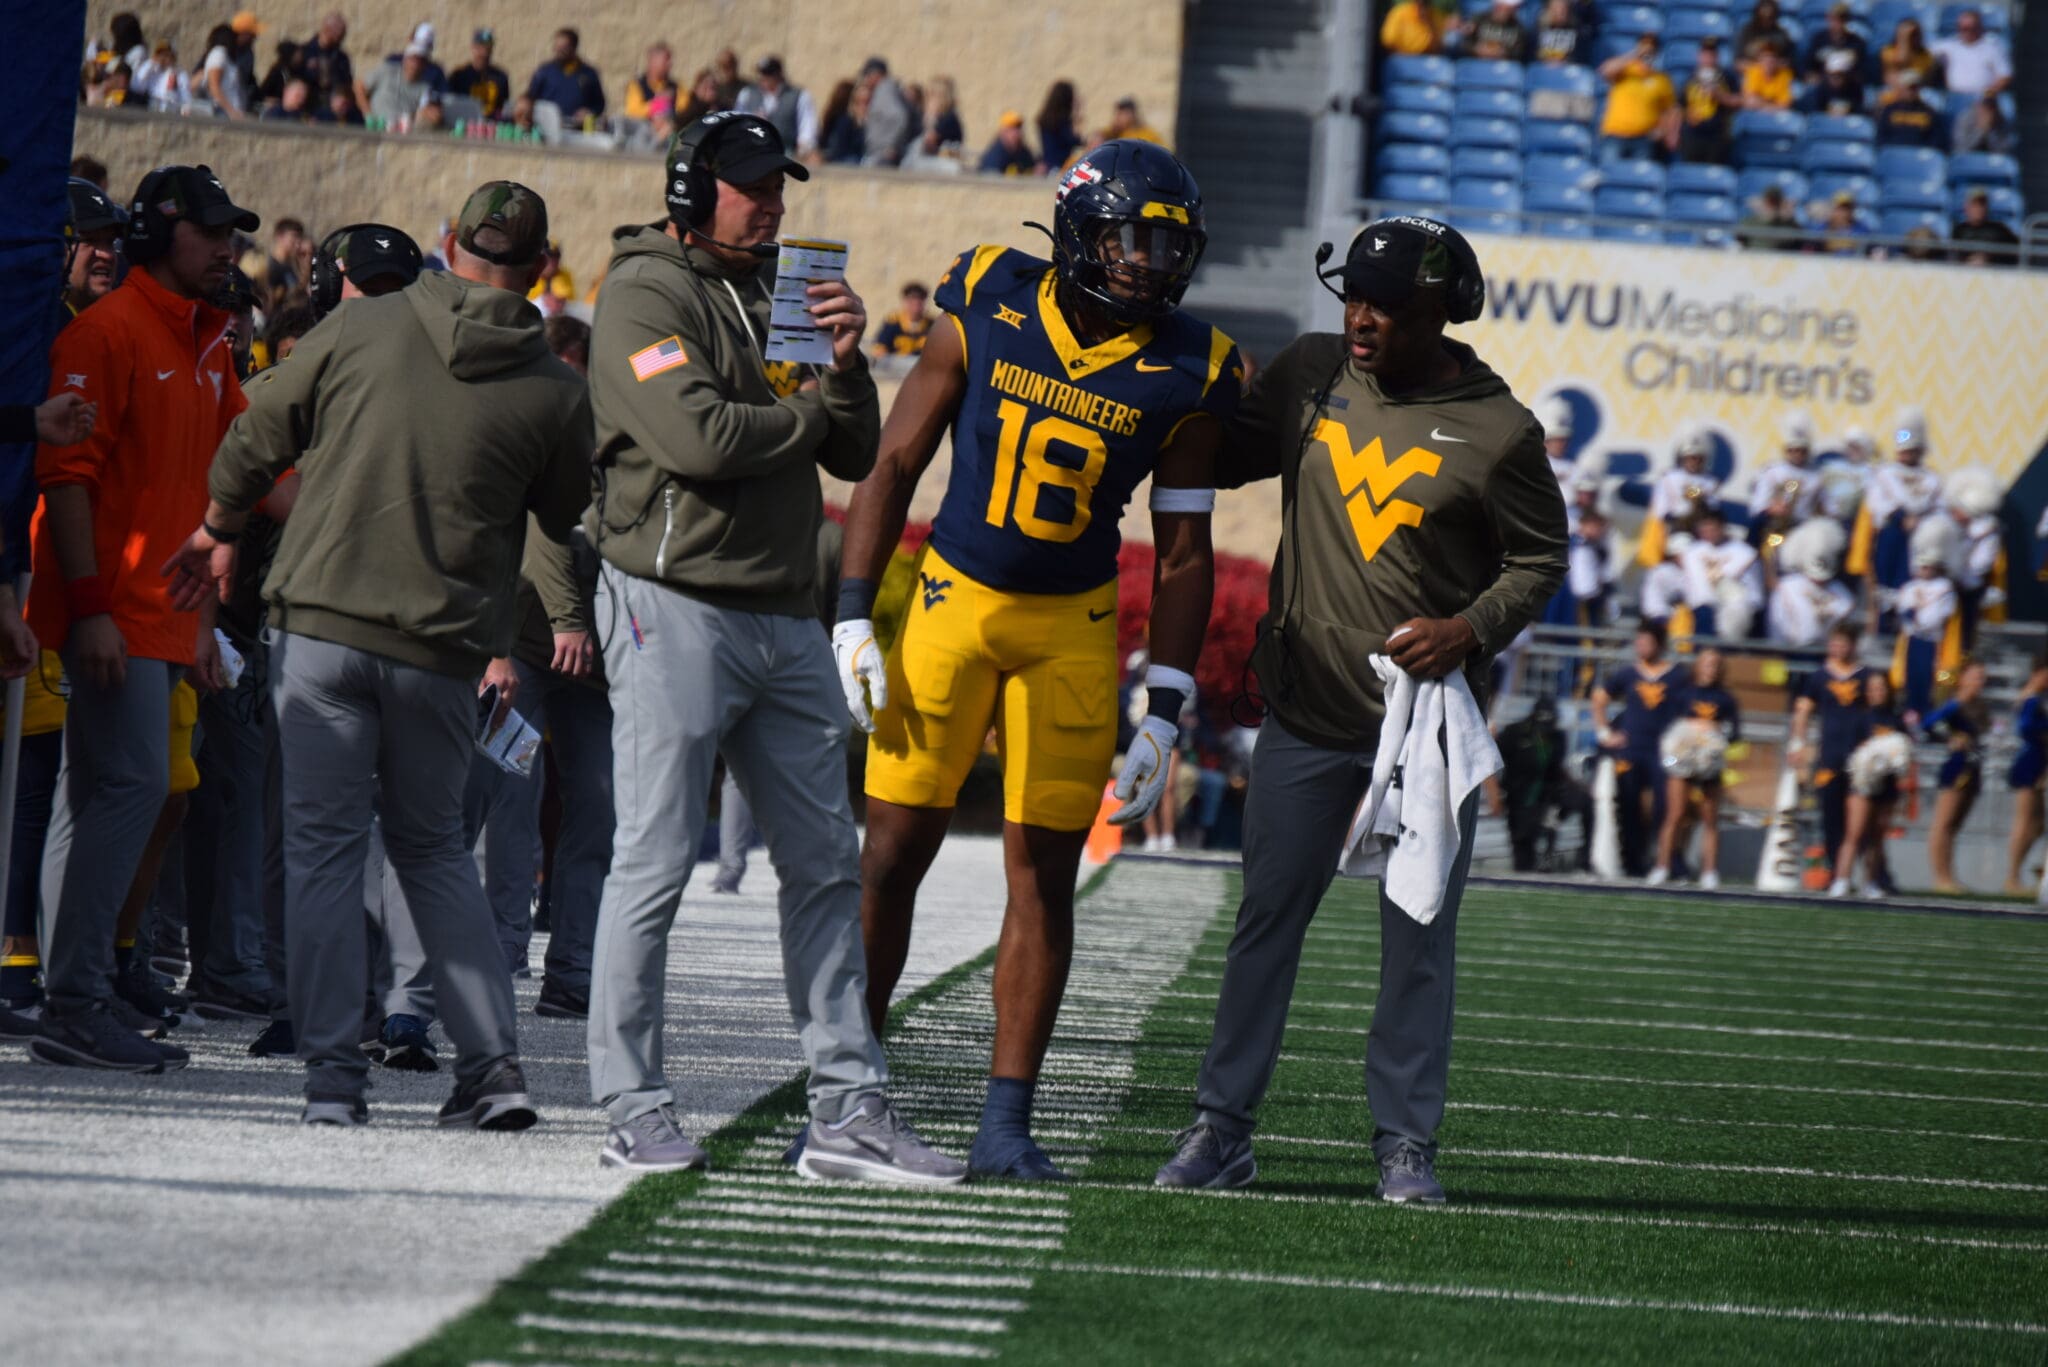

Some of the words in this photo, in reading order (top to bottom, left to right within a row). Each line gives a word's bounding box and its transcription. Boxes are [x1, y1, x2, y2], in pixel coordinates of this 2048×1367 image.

[989, 358, 1142, 437] MOUNTAINEERS
[1624, 341, 1874, 404] Children's
[985, 397, 1108, 543] 18
